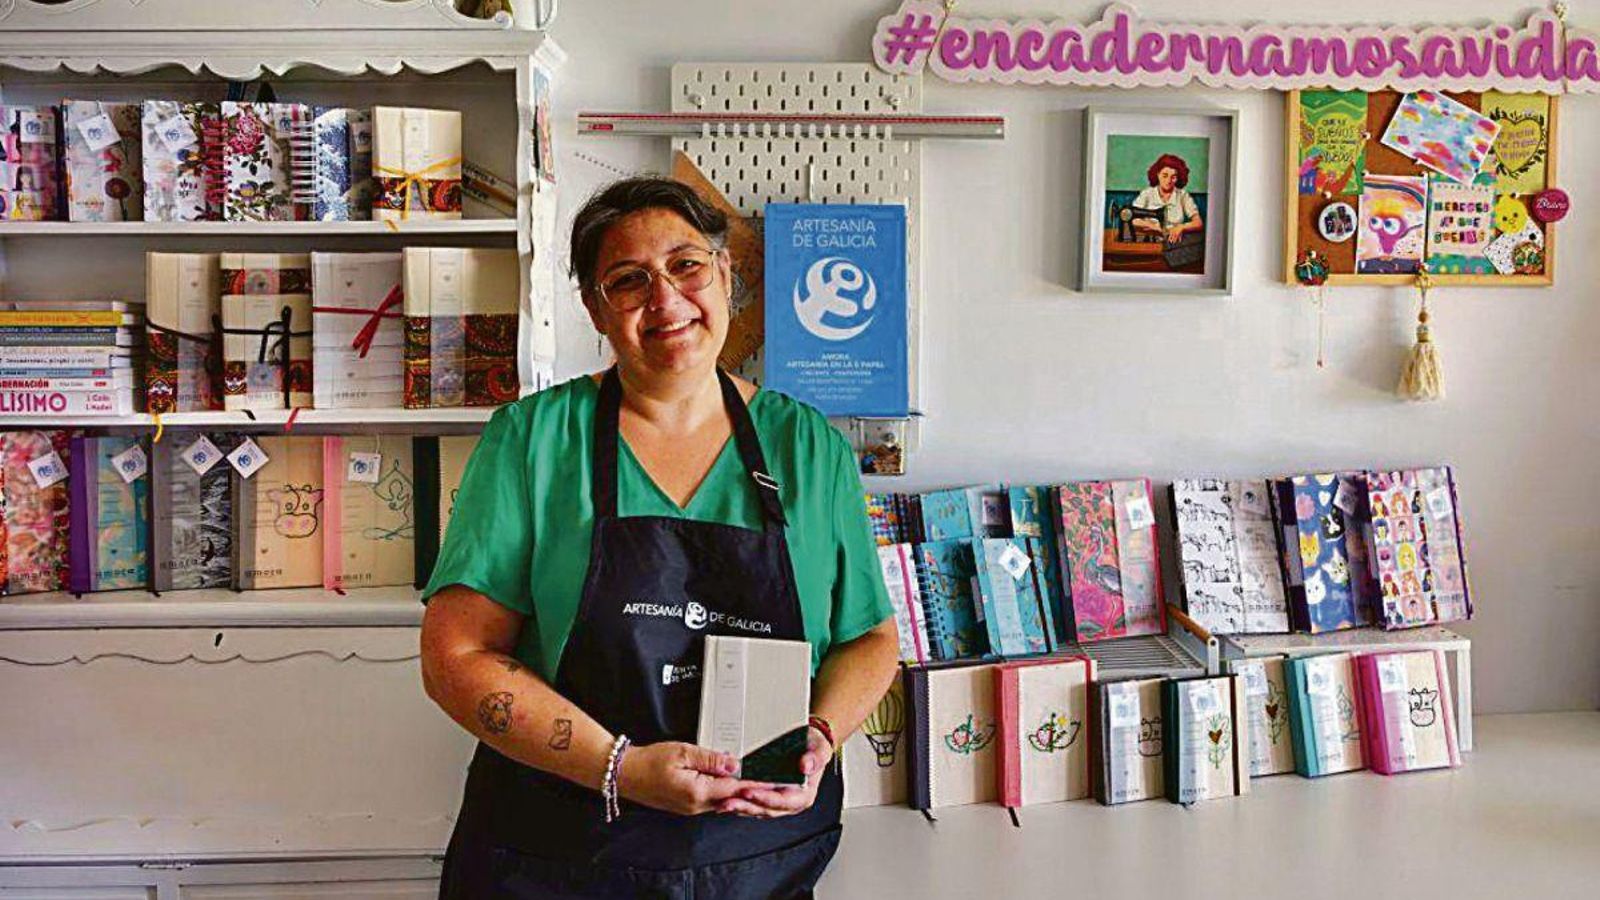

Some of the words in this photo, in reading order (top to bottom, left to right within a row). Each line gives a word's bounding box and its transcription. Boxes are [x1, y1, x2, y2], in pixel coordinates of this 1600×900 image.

[884, 13, 1600, 82] #encadernamosavida
[792, 217, 876, 233] ARTESANÍA
[792, 234, 813, 247] DE
[816, 234, 877, 248] GALICIA
[623, 602, 683, 617] ARTESANÍA
[709, 611, 725, 623] DE
[727, 616, 772, 633] GALICIA
